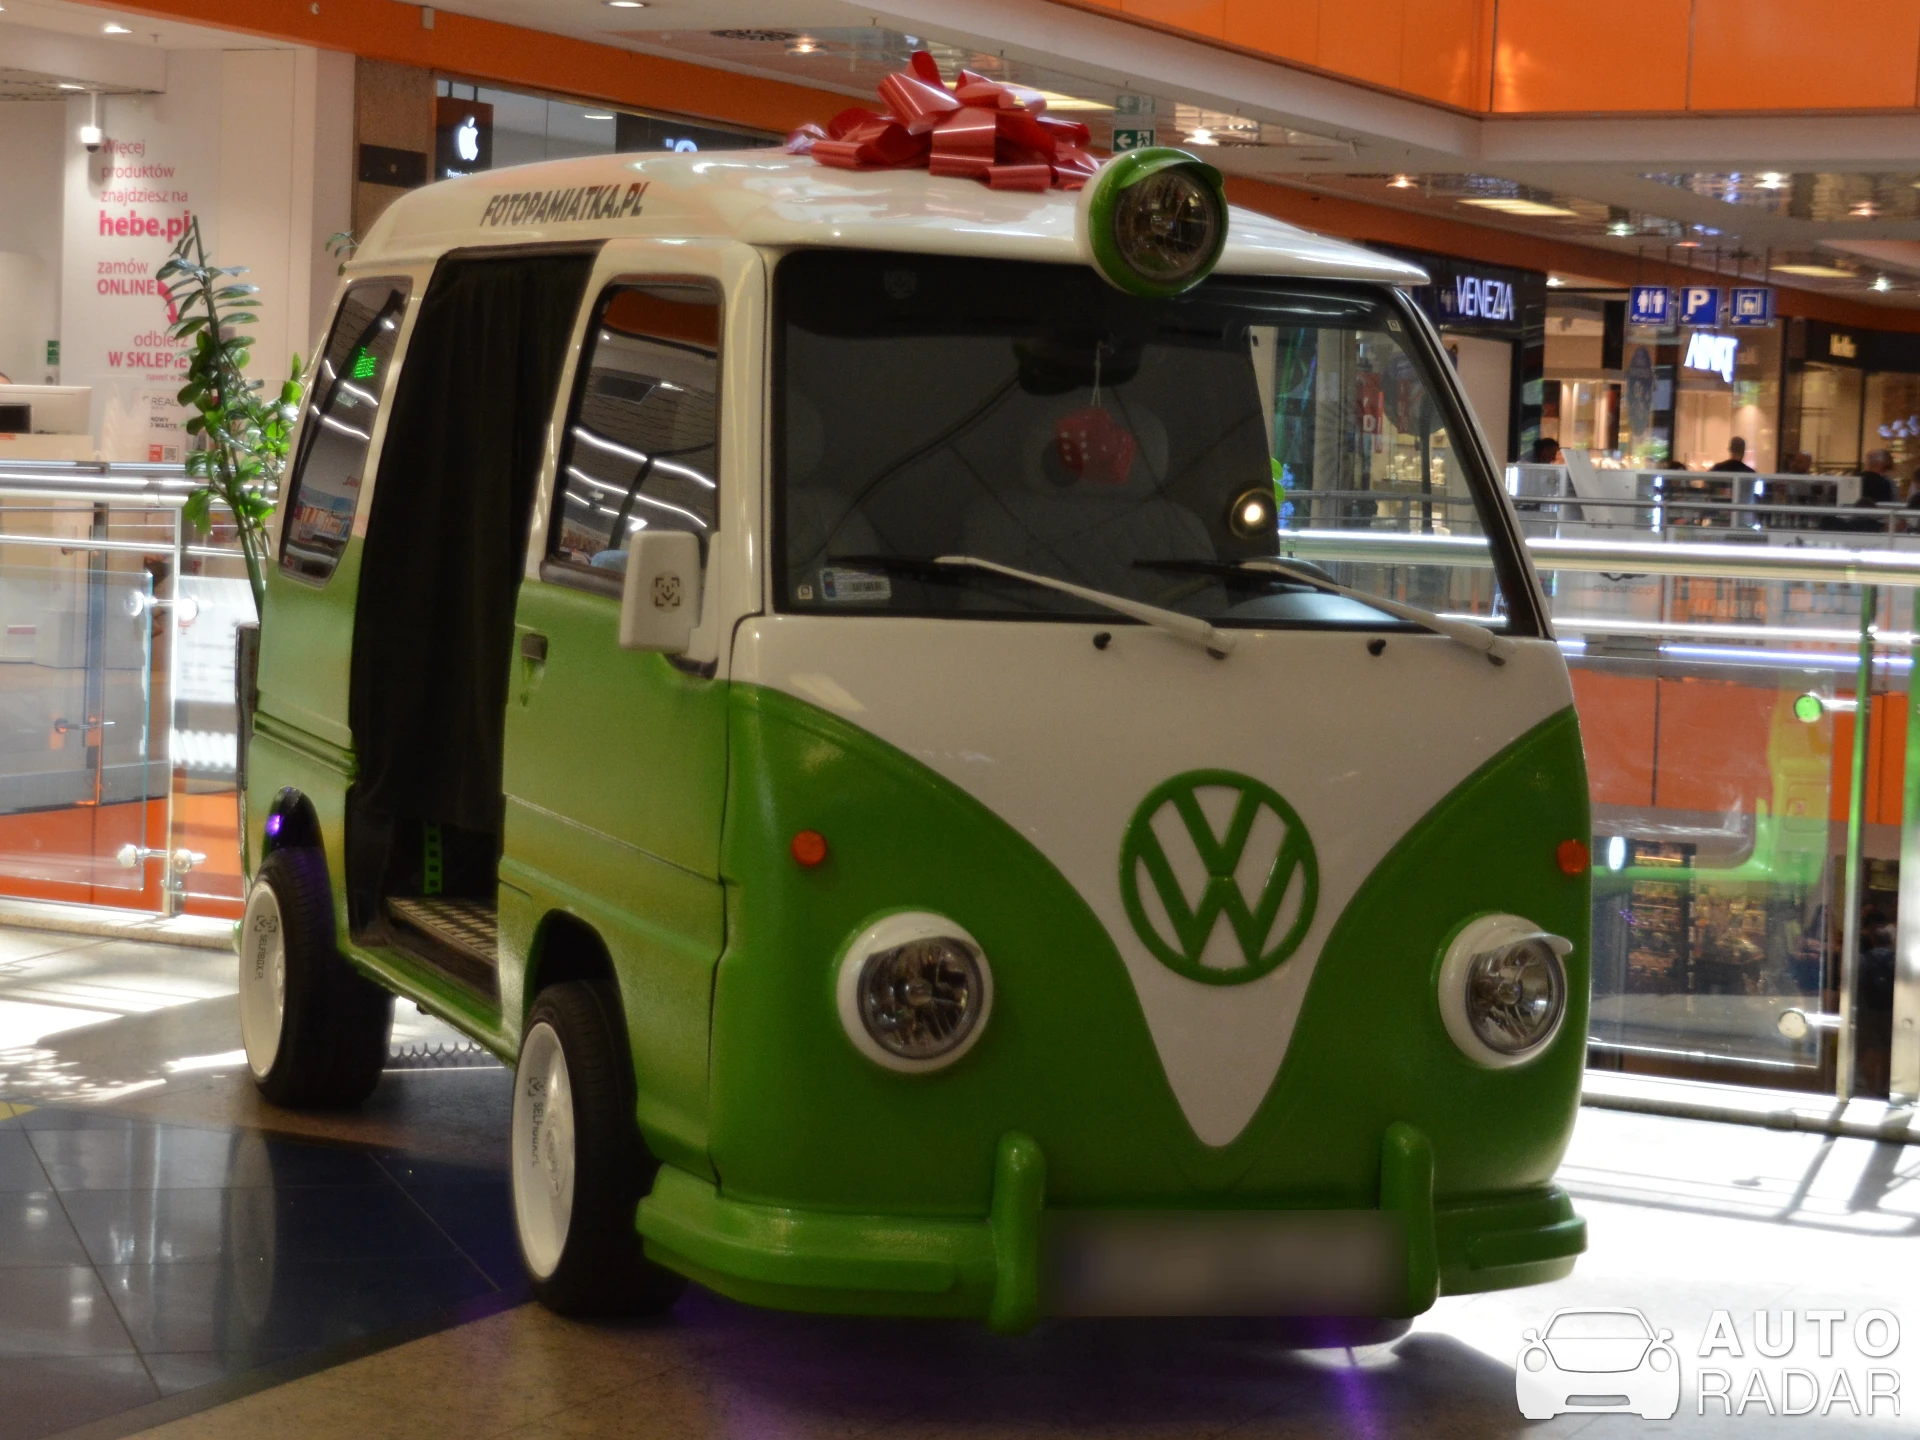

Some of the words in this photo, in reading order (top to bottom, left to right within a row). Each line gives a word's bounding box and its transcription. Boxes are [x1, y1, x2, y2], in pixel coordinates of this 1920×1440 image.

[101, 163, 175, 182] produktów
[101, 187, 169, 206] znajdziesz
[172, 191, 188, 202] na
[479, 181, 650, 227] FOTOPAMIATKA.PL
[99, 209, 191, 243] hebe.pl
[97, 258, 149, 274] zamów
[97, 279, 156, 296] ONLINE
[1456, 275, 1515, 321] VENEZIA
[1688, 289, 1710, 315] P
[108, 351, 123, 368] W
